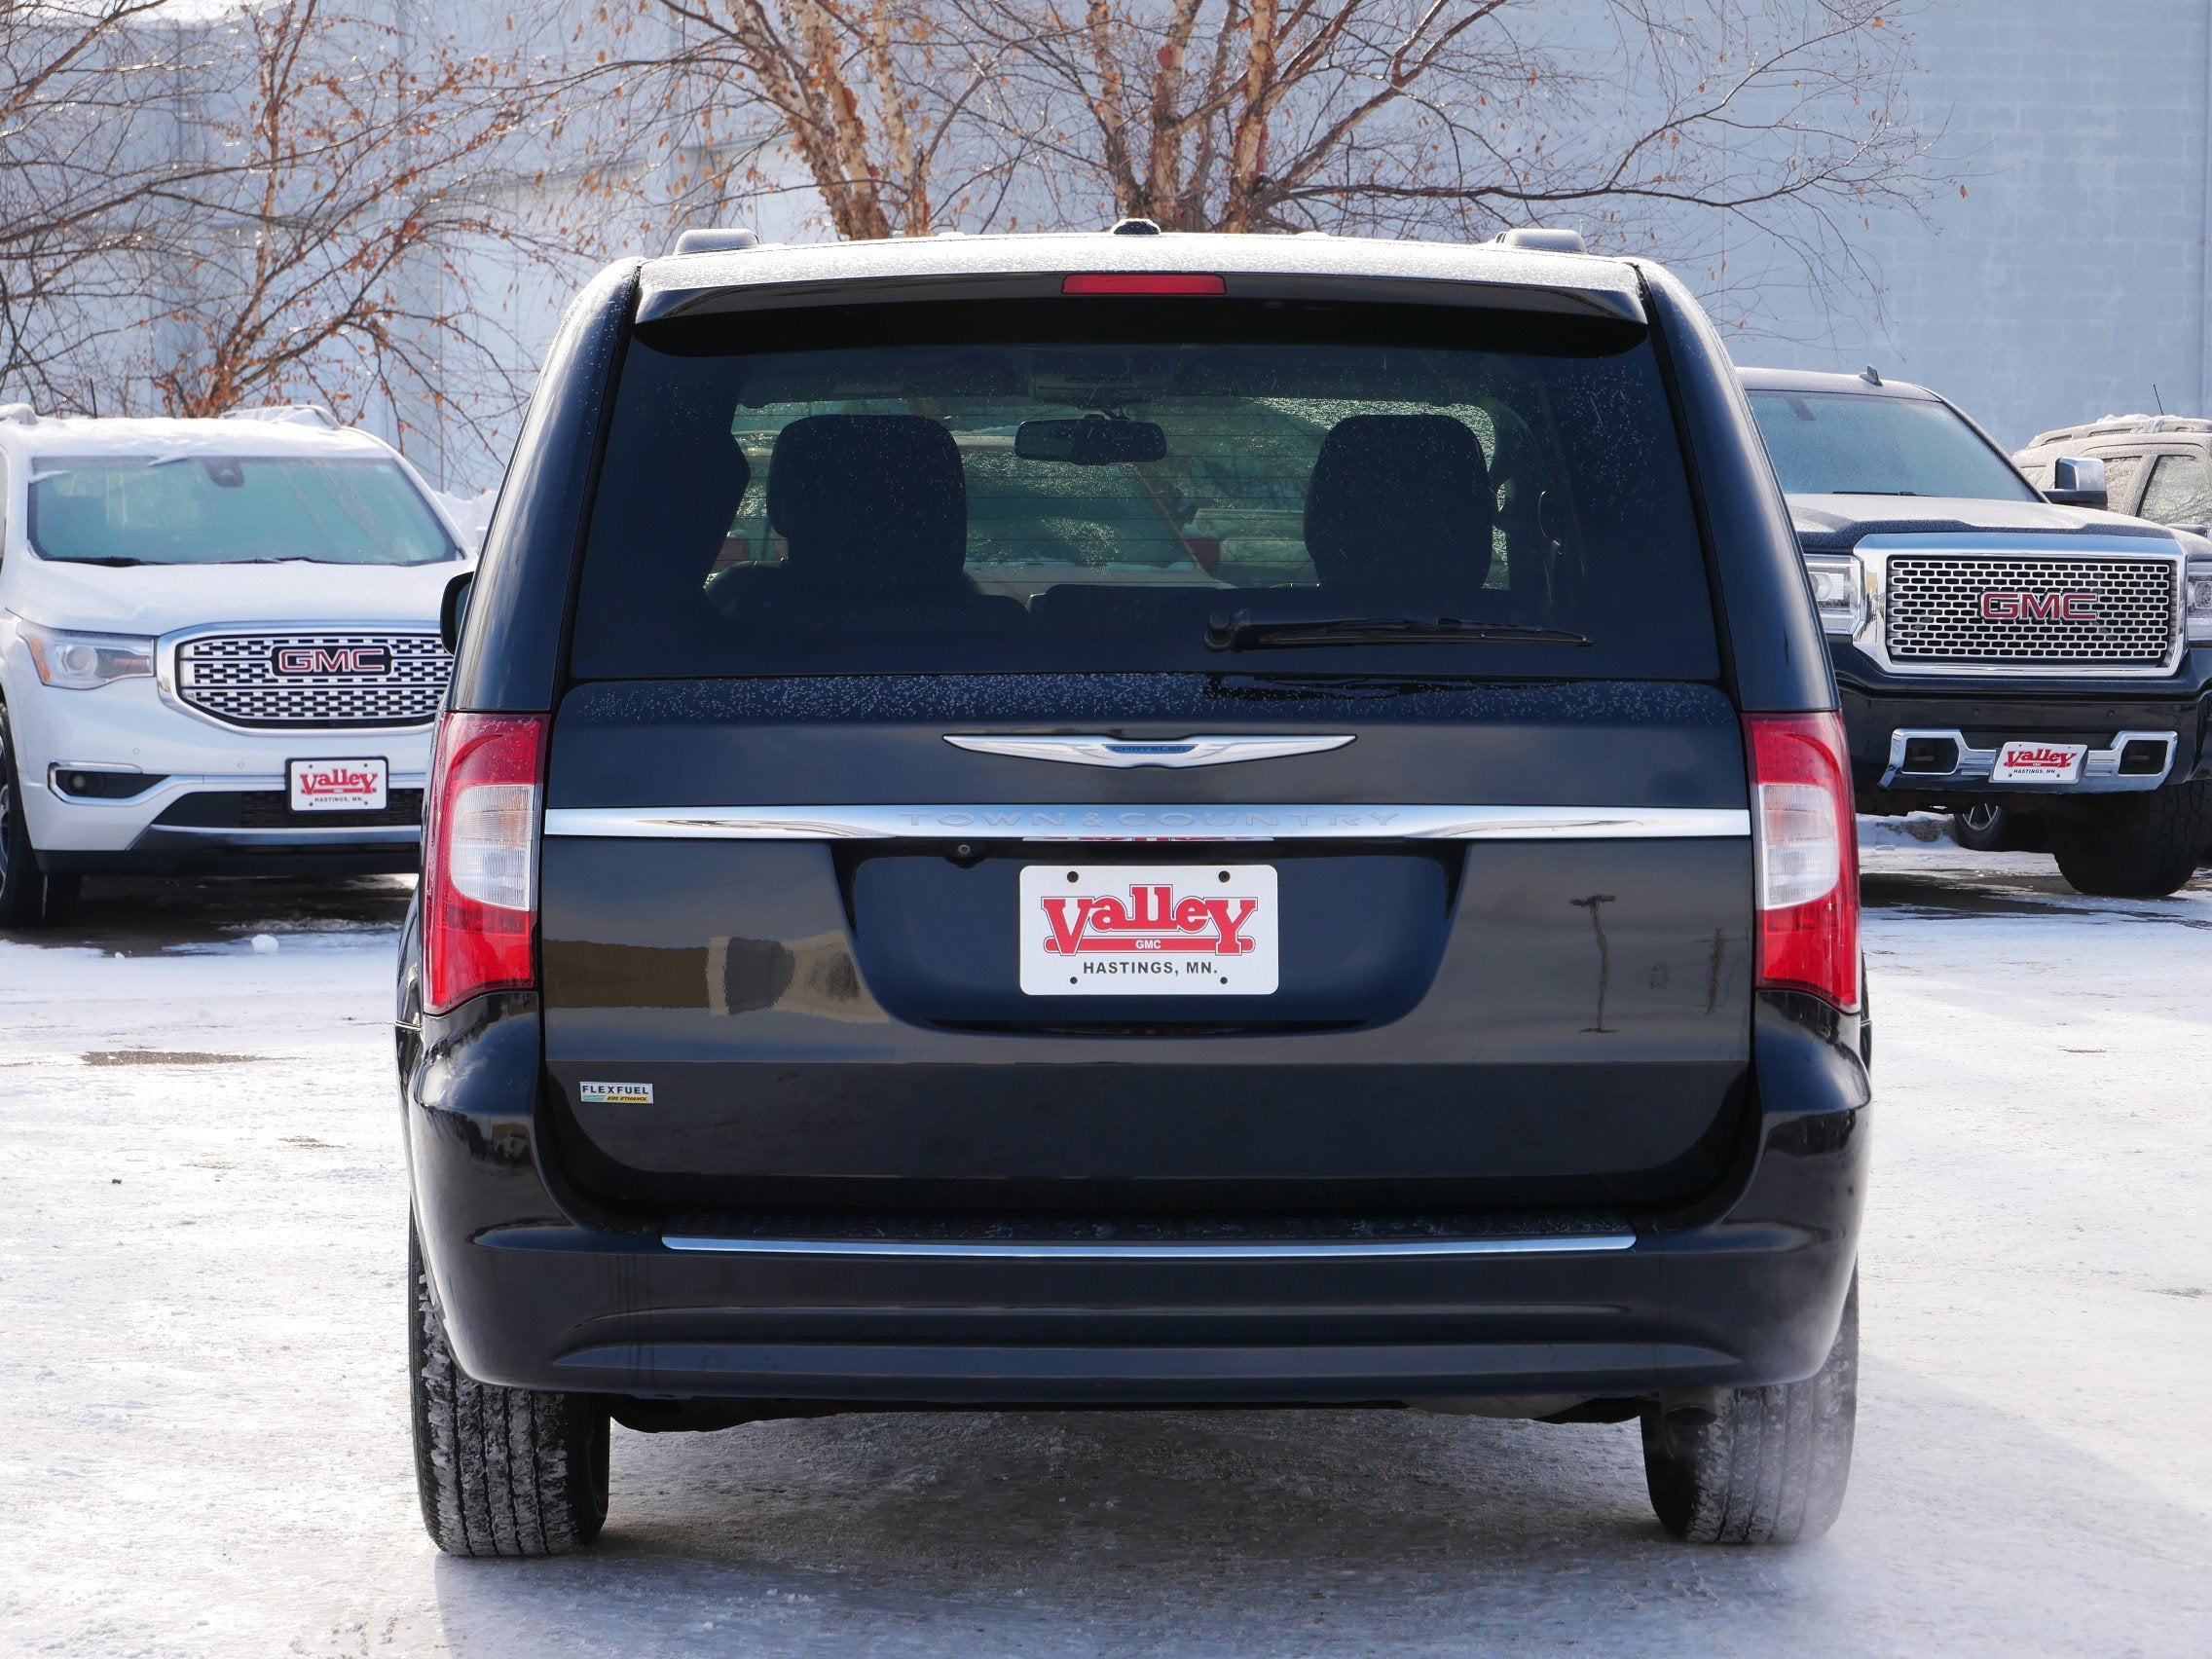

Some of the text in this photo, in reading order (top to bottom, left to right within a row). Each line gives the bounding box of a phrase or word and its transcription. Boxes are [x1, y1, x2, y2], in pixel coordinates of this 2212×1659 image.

[1981, 592, 2098, 621] GMC
[278, 648, 386, 672] GMC
[1135, 940, 1161, 950] GMC
[1083, 961, 1218, 976] HASTINGS, MN.
[582, 1085, 649, 1094] FLEXFUEL
